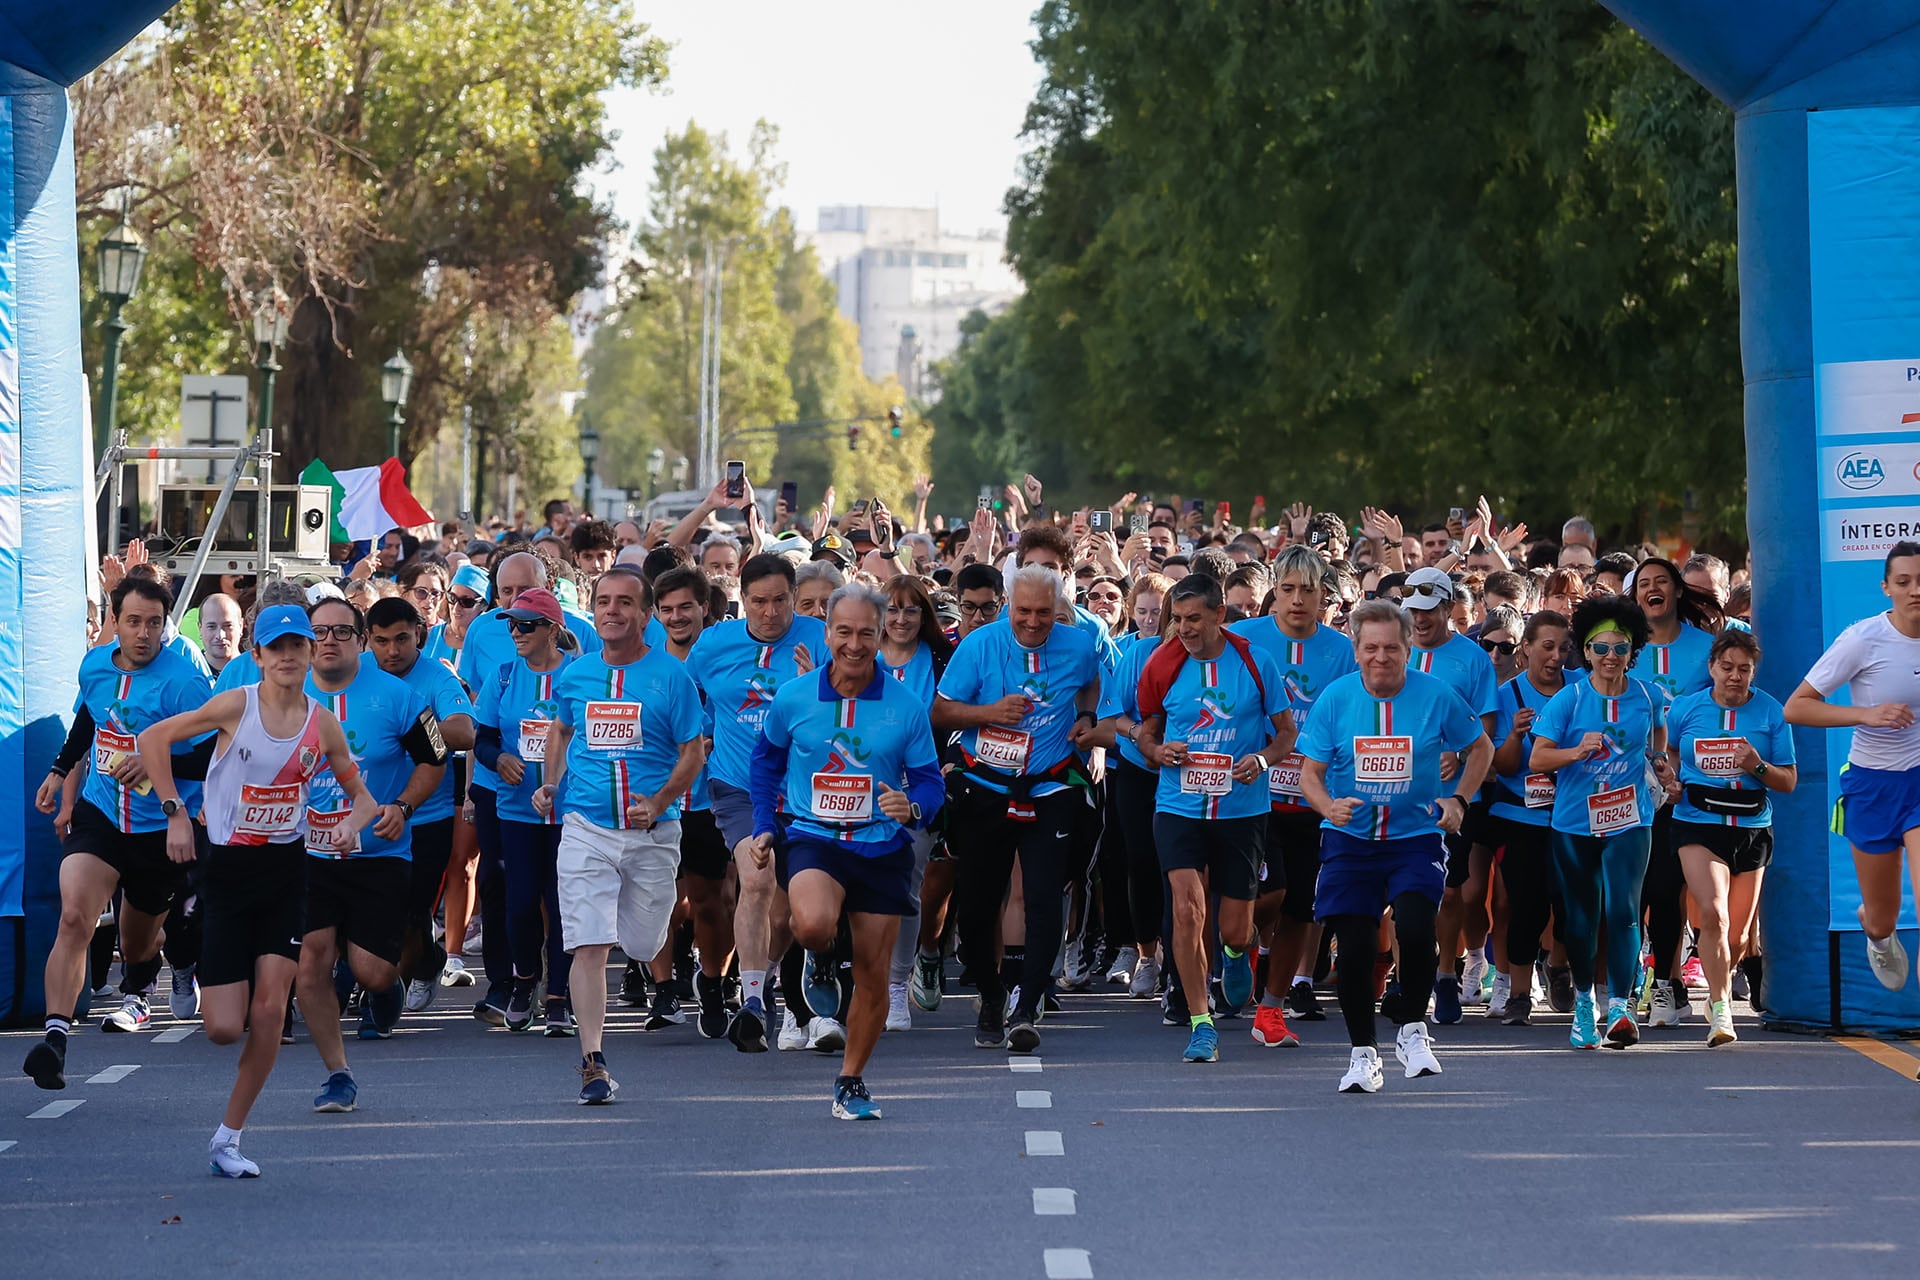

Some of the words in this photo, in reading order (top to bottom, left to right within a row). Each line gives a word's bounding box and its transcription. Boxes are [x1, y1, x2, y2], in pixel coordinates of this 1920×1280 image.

[1842, 459, 1885, 478] AEA
[1841, 519, 1920, 539] ÍNTEGRA
[593, 723, 634, 738] C7285
[981, 742, 1018, 761] C7210
[1362, 757, 1406, 772] C6616
[1187, 771, 1227, 786] C6292
[819, 794, 866, 811] C6987
[245, 807, 294, 825] C7142
[1596, 804, 1632, 825] C6242
